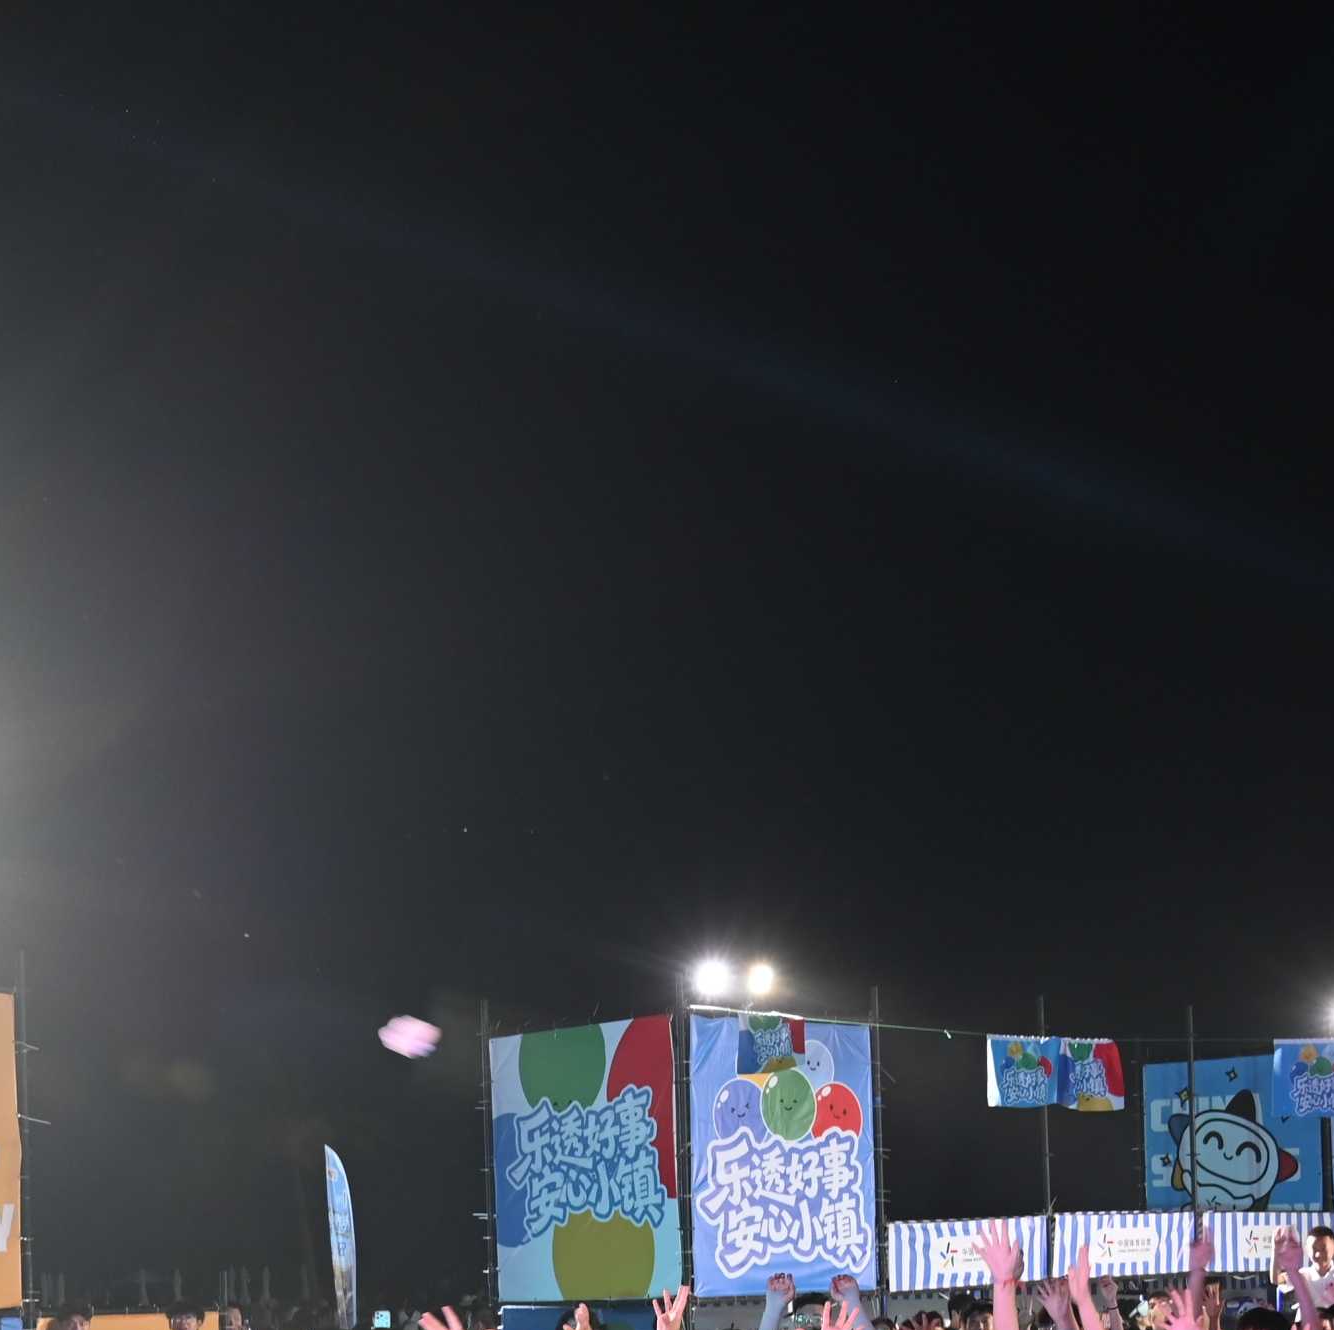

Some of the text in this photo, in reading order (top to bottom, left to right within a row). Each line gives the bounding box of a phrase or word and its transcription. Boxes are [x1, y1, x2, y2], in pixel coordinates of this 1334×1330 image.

[512, 1094, 655, 1183] 乐透好事
[704, 1139, 855, 1215] 乐透好事
[529, 1155, 664, 1233] 安心小镇
[726, 1197, 864, 1268] 安心小镇
